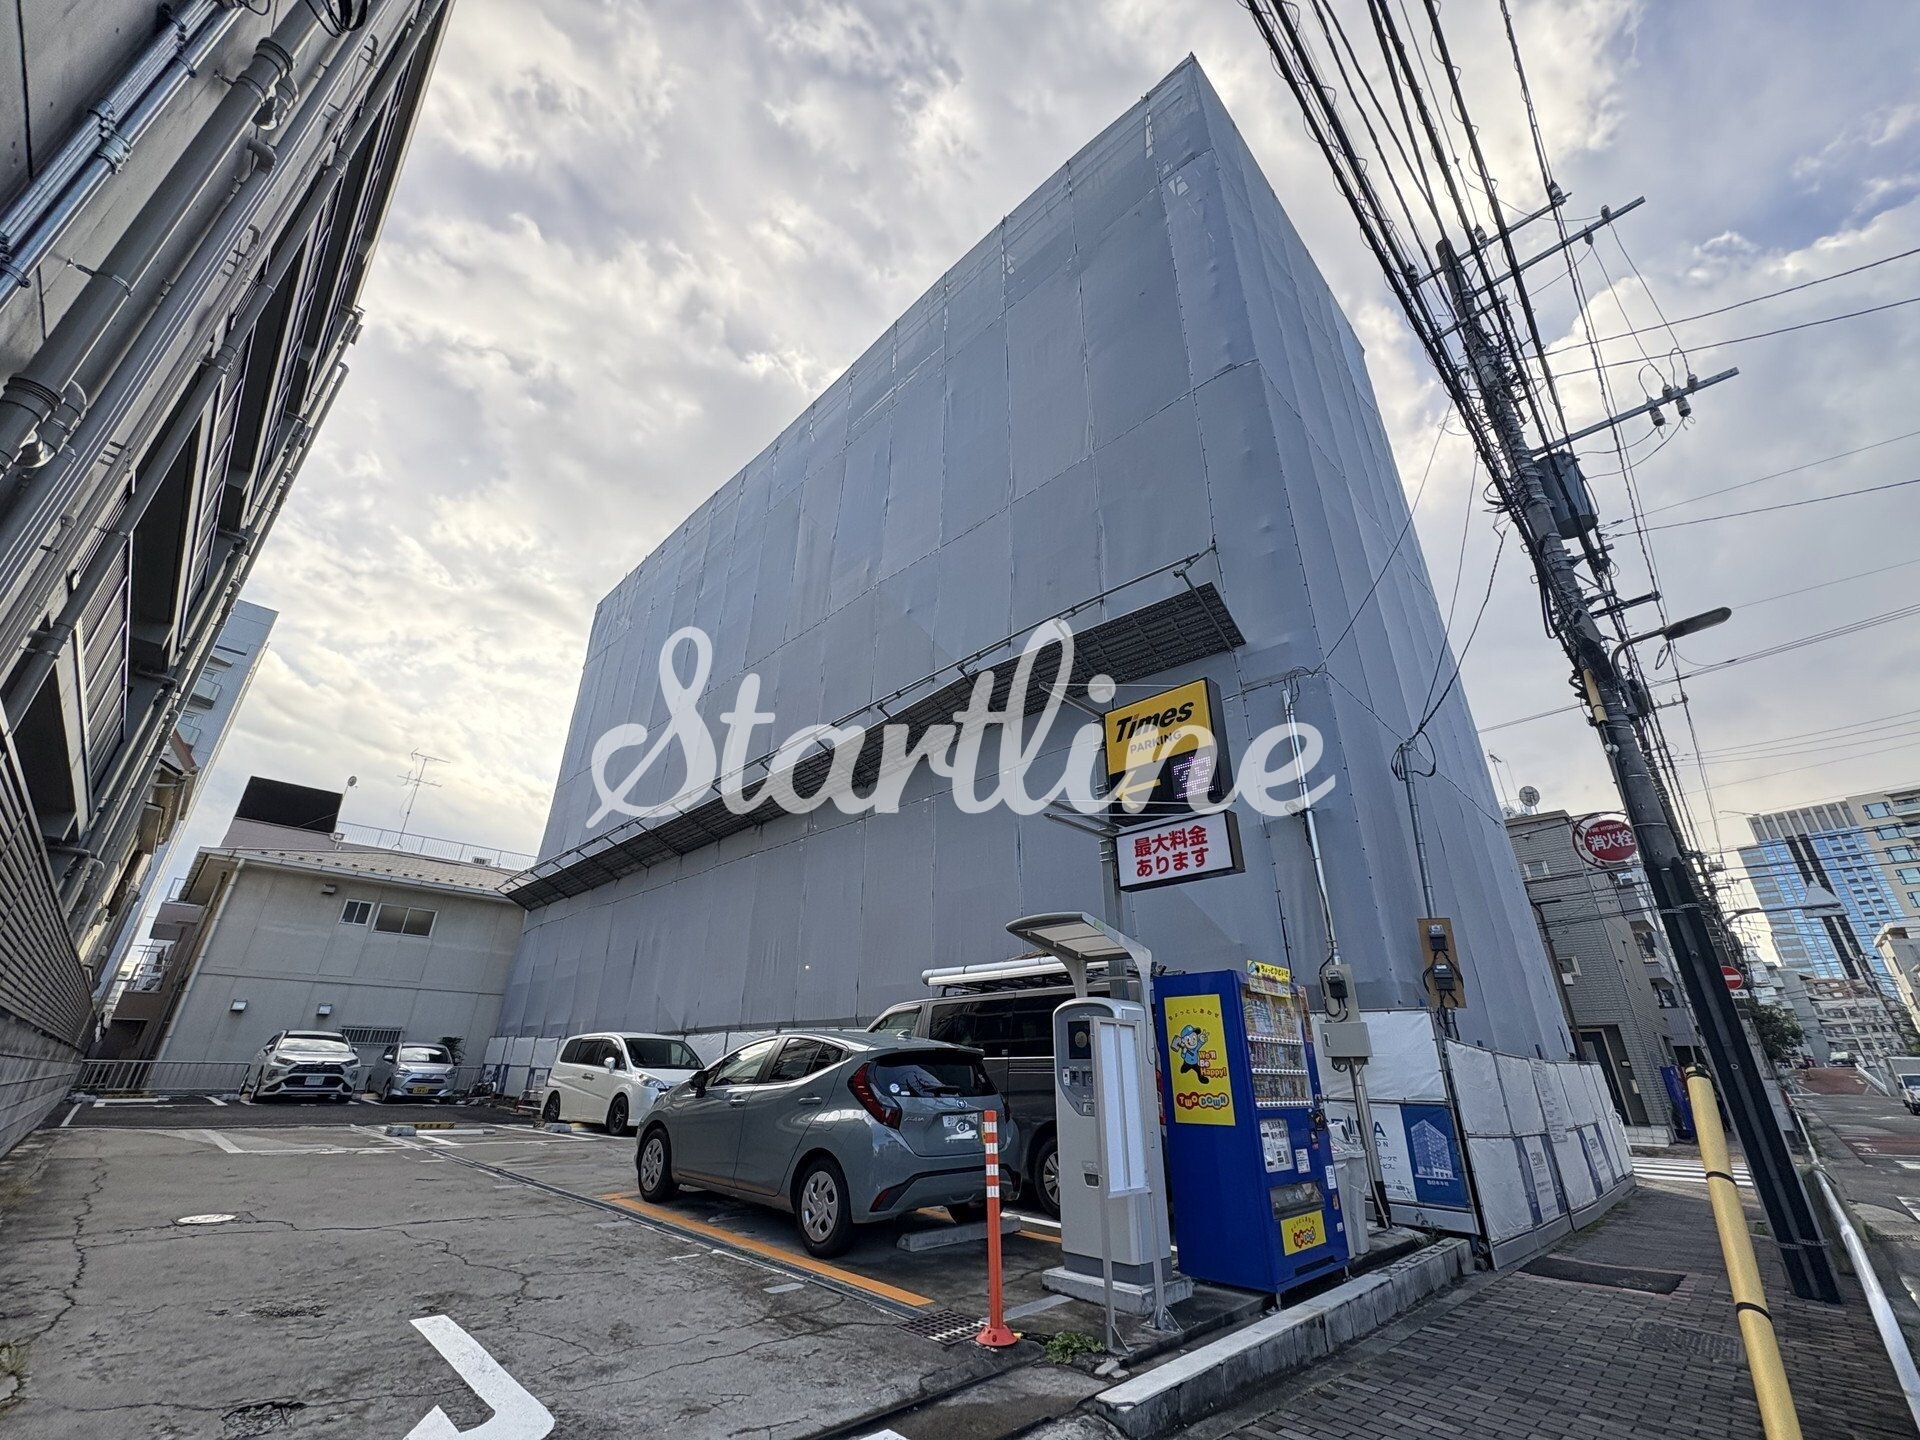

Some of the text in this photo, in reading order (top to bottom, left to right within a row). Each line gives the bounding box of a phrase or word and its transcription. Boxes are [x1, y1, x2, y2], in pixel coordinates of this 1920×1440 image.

[1116, 702, 1195, 743] Times
[1130, 730, 1182, 755] PARKING
[1134, 825, 1208, 858] 最大料金
[1587, 830, 1636, 852] 消火栓
[1136, 847, 1210, 878] あります
[1200, 1060, 1211, 1068] Be
[1200, 1067, 1227, 1078] Happy!
